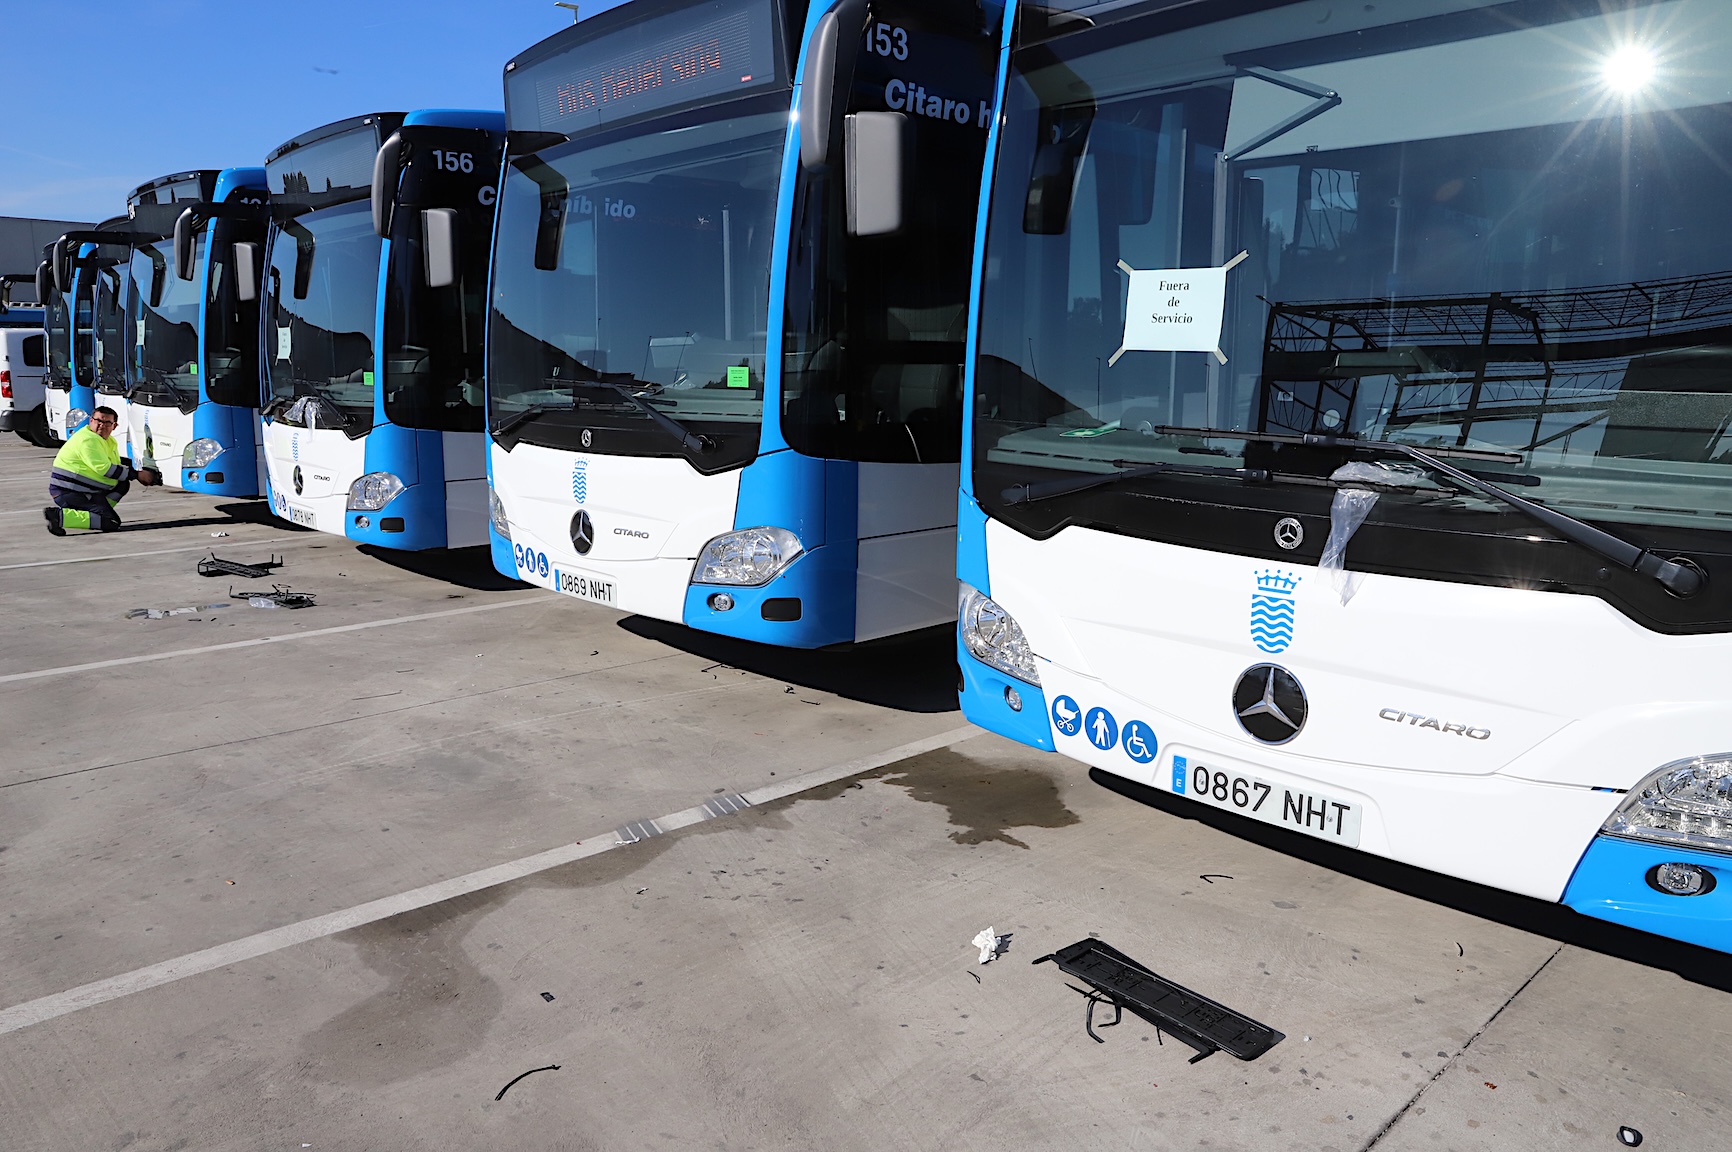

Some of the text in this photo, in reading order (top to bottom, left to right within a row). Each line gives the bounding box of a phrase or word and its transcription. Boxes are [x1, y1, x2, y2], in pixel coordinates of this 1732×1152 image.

[866, 22, 909, 61] 153
[884, 78, 970, 125] Citaro
[432, 150, 474, 173] 156
[1159, 280, 1190, 291] Fuera
[1167, 296, 1180, 307] de
[1151, 312, 1193, 324] Servicio
[613, 527, 650, 539] CITARO
[561, 573, 612, 602] 0869 NHT
[1378, 707, 1492, 741] CITARO
[1176, 778, 1183, 789] E
[1192, 766, 1351, 836] 0867 NHT
